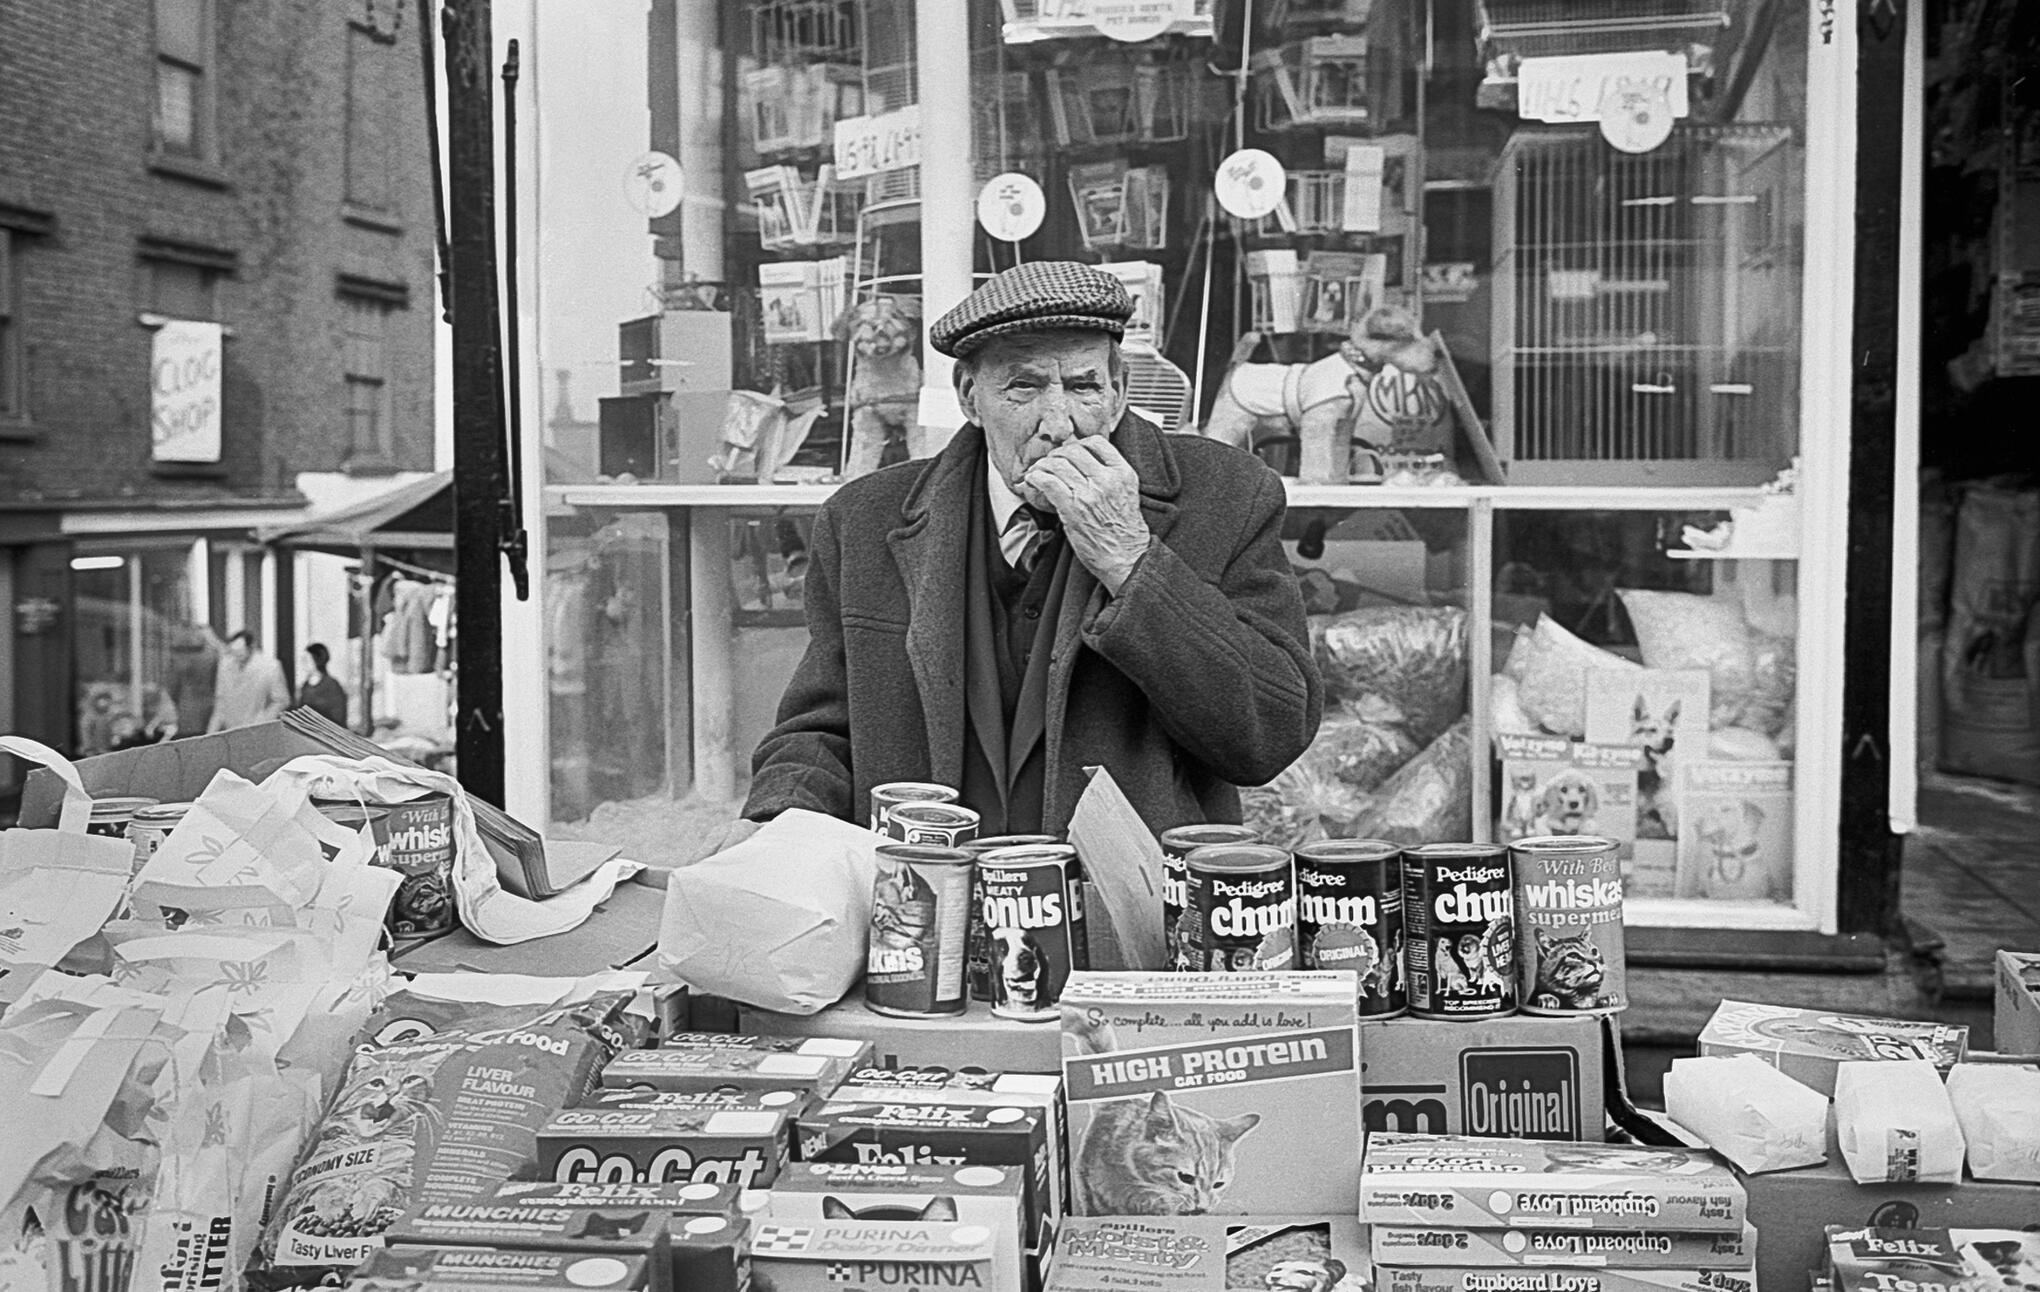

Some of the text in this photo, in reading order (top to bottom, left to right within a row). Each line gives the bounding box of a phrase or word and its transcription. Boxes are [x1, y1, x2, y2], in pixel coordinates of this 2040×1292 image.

[1538, 859, 1585, 875] With
[1319, 944, 1368, 961] ORIGINAL
[1087, 1007, 1109, 1028] So
[1208, 1018, 1230, 1032] you
[1233, 1013, 1260, 1028] add
[1262, 1015, 1272, 1028] is
[1276, 1012, 1312, 1029] love!
[467, 1066, 513, 1082] LIVER
[1090, 1055, 1171, 1086] HIGH
[1175, 1069, 1247, 1088] CAT FOOD
[462, 1078, 535, 1098] FLAVOUR
[652, 1093, 748, 1104] Felix
[875, 1105, 976, 1121] Felix
[1471, 1079, 1570, 1137] Original
[345, 1148, 375, 1167] SIZE
[556, 1184, 663, 1197] Felix
[1440, 1194, 1454, 1210] 2
[1517, 1190, 1660, 1218] Cupboard Love
[425, 1205, 574, 1221] MUNCHIES
[1699, 1208, 1734, 1219] Tasty
[824, 1229, 930, 1241] PURINA
[1062, 1228, 1177, 1252] Moist
[1455, 1233, 1469, 1249] 2
[291, 1238, 322, 1260] Tasty
[325, 1245, 358, 1259] Liver
[899, 1243, 985, 1254] Dinner
[1531, 1232, 1673, 1256] Cupboard Love
[1710, 1243, 1745, 1256] Tasty
[1866, 1238, 1945, 1256] Felix
[441, 1253, 563, 1267] MUNCHIES
[1068, 1240, 1201, 1270] Meaty
[859, 1263, 982, 1287] PURINA
[1100, 1275, 1110, 1284] 4
[1390, 1271, 1423, 1283] Tasty
[1462, 1272, 1600, 1292] Cupboard Love
[1699, 1271, 1712, 1286] 2
